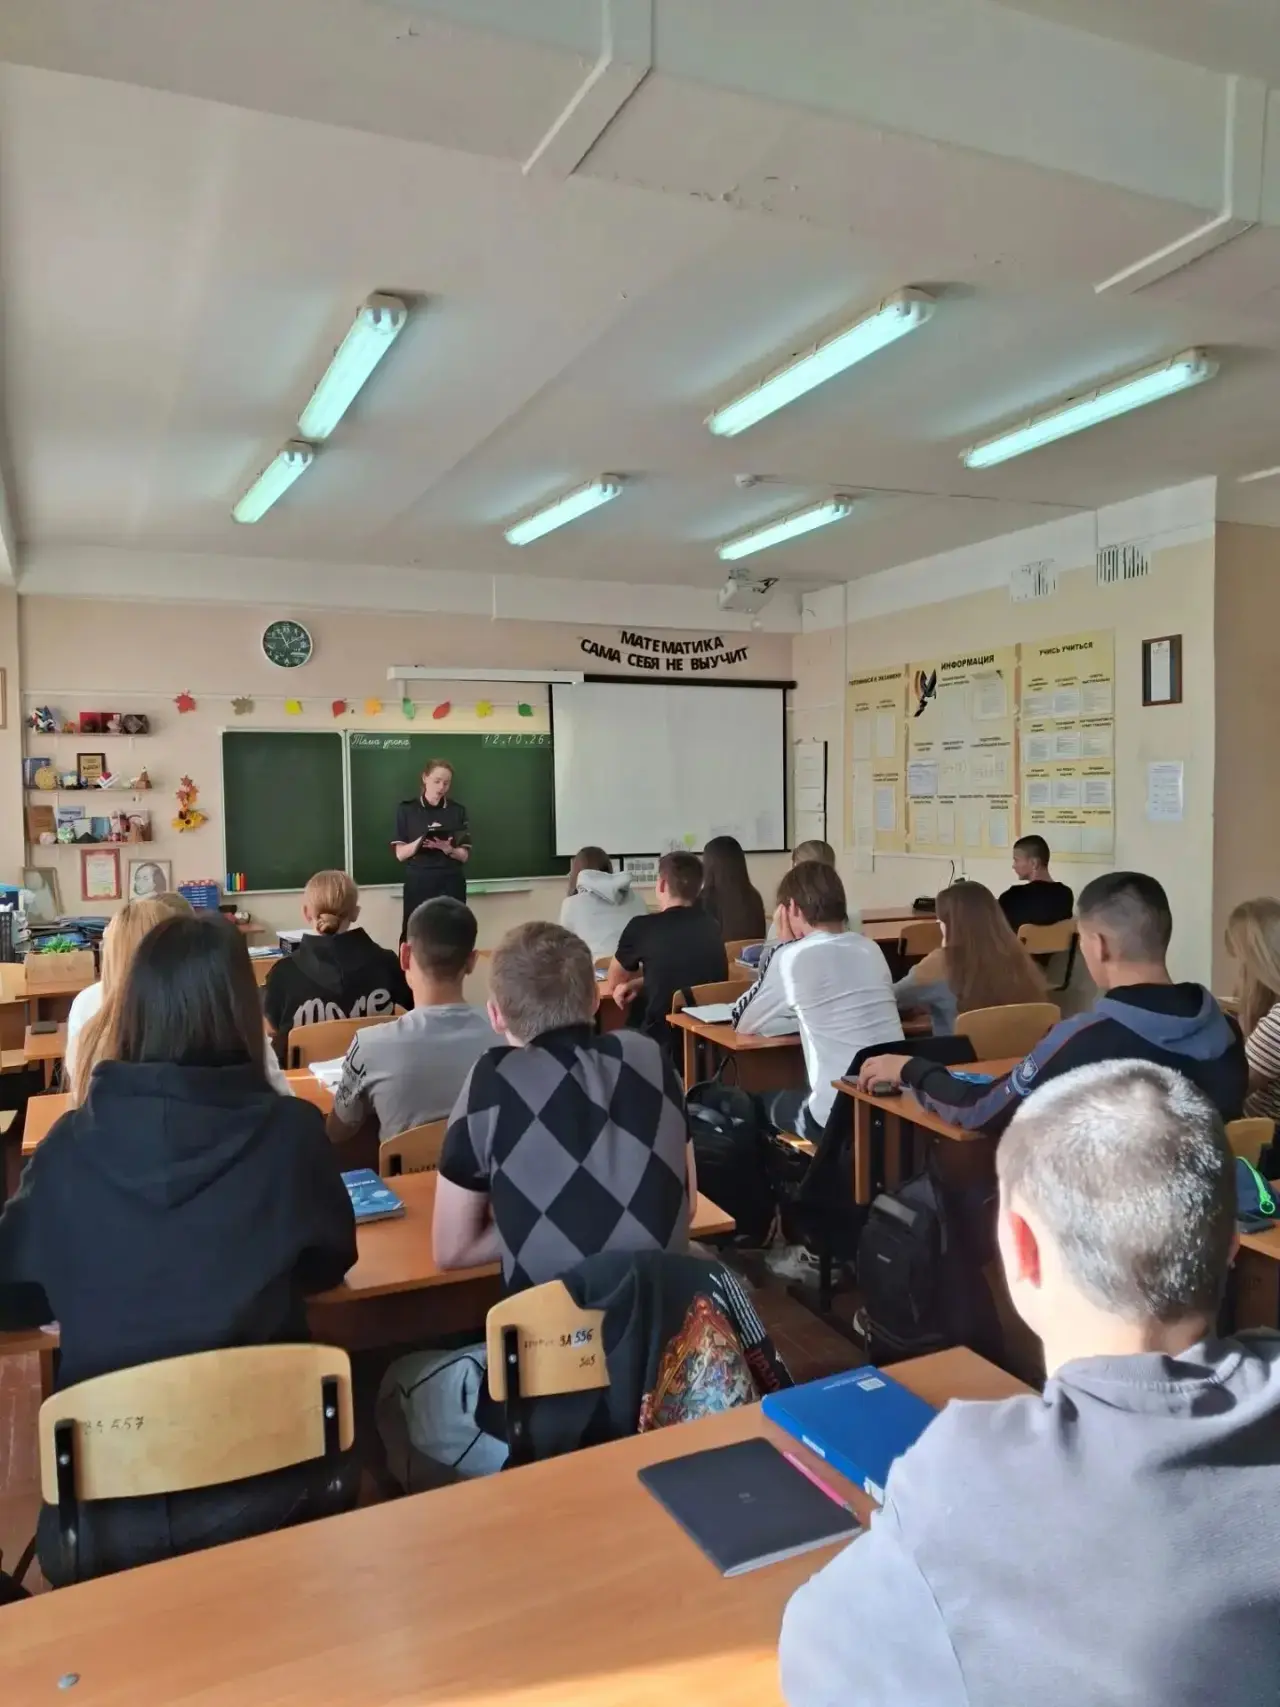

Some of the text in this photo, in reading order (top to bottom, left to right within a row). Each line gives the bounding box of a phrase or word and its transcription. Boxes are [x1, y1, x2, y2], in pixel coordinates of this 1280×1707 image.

[621, 631, 724, 654] МАТЕМАТИКА
[1039, 641, 1093, 656] УЧИСЬ УЧИТЬСЯ
[580, 638, 748, 671] САМА СЕБЯ НЕ ВЫУЧИТ
[941, 654, 994, 671] ИНФОРМАЦИЯ
